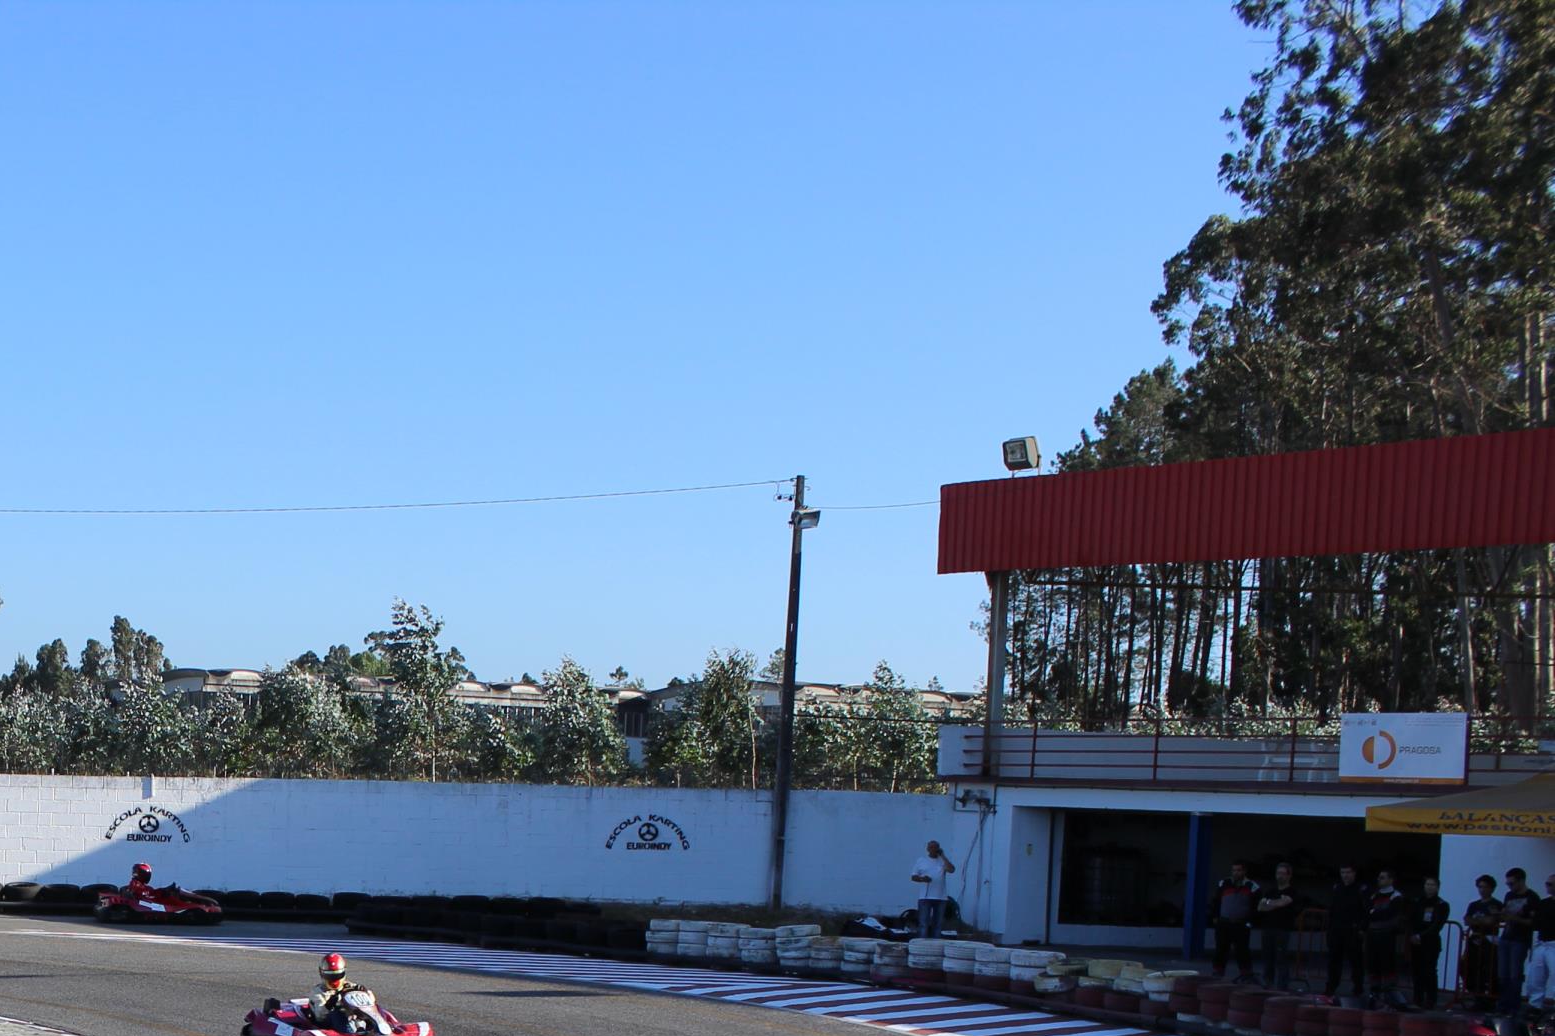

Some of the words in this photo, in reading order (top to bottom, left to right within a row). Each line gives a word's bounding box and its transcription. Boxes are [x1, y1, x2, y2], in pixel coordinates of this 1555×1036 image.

[1399, 746, 1441, 754] PRAGOSA
[105, 806, 142, 840] ESCOLA
[149, 805, 191, 843] KARTING
[605, 815, 642, 850] ESCOLA
[648, 814, 690, 851] KARTING
[126, 833, 172, 842] EUROINDY
[626, 842, 672, 850] EUROINDY
